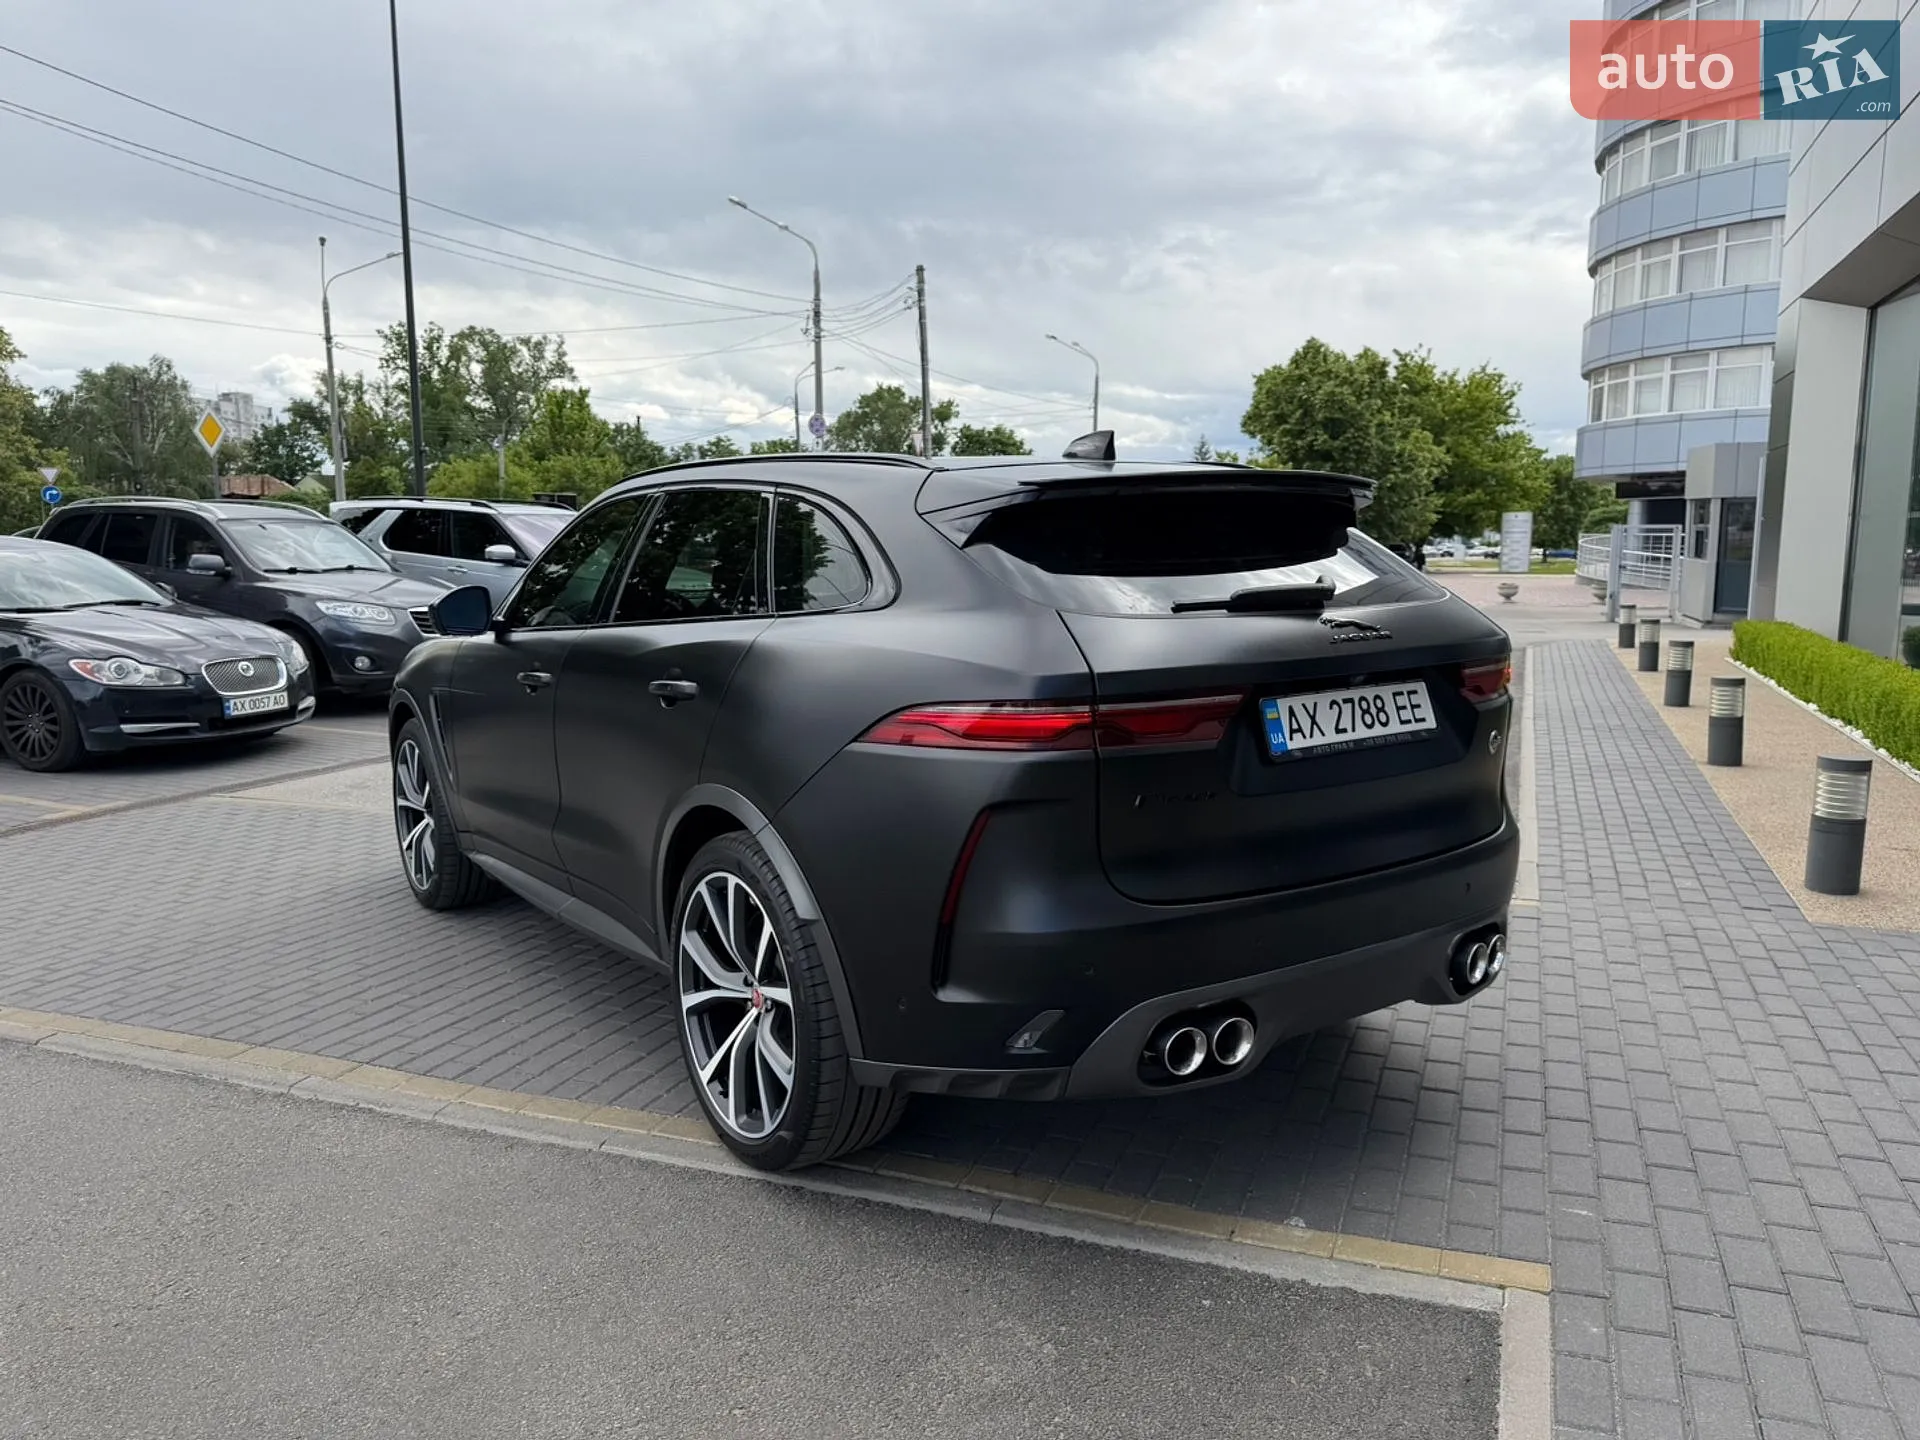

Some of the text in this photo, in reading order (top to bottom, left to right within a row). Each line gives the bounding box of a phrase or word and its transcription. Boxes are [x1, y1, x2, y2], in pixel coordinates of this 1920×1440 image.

[232, 700, 247, 713] AX
[248, 696, 271, 710] 0057
[1287, 689, 1427, 742] AX 2788 EE
[1270, 733, 1285, 745] UA
